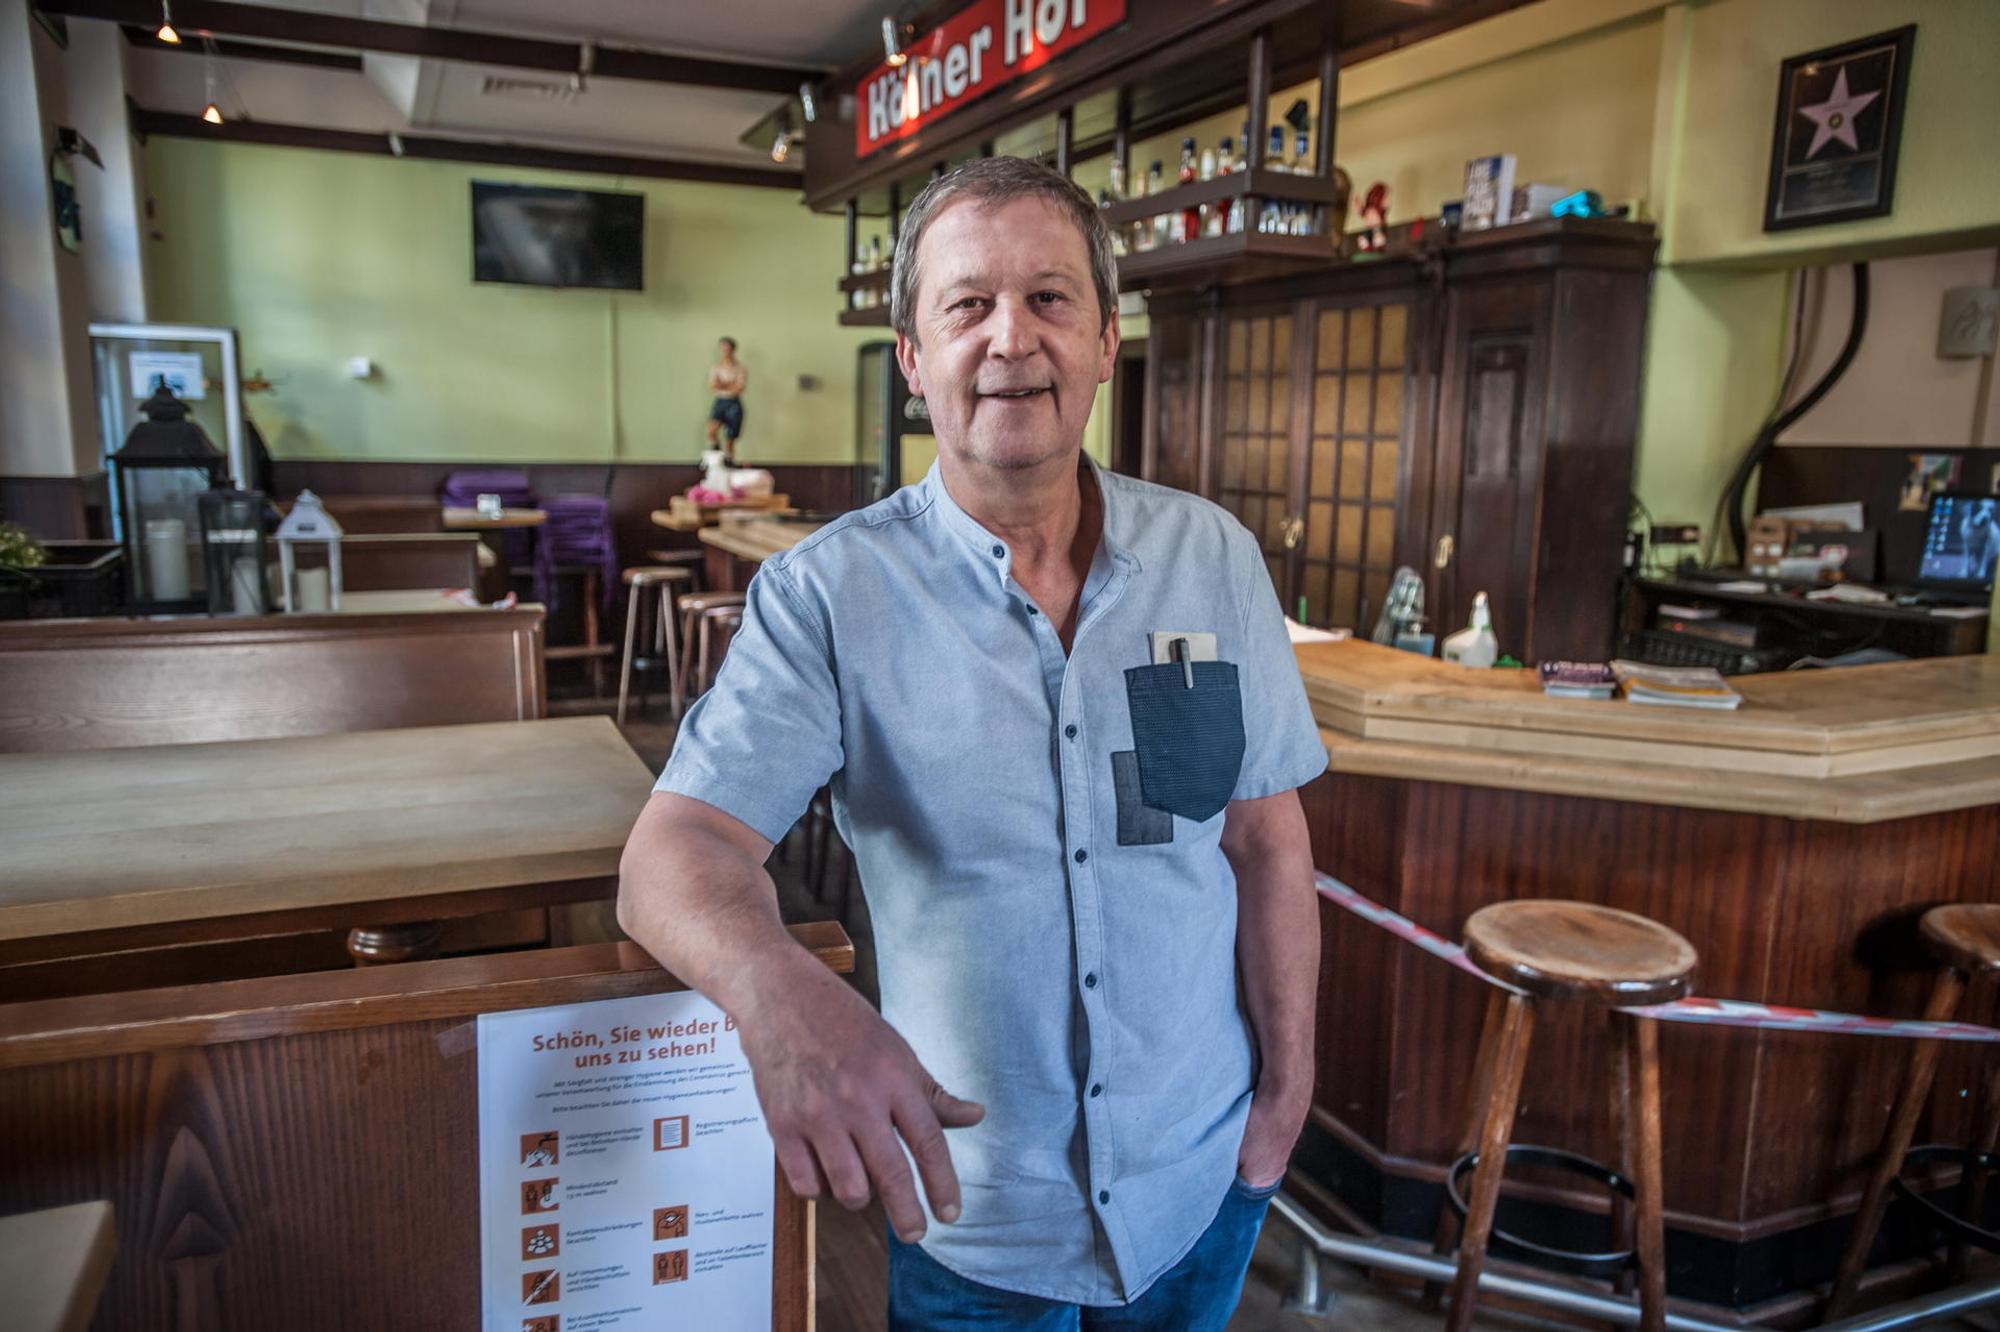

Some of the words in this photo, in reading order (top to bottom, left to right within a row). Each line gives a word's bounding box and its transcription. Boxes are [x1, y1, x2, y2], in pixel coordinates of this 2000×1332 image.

[532, 1030, 604, 1052] Schön,
[610, 1025, 641, 1044] Sie
[646, 1018, 719, 1040] wieder
[574, 1050, 612, 1068] uns
[617, 1048, 641, 1063] zu
[647, 1038, 715, 1058] sehen!
